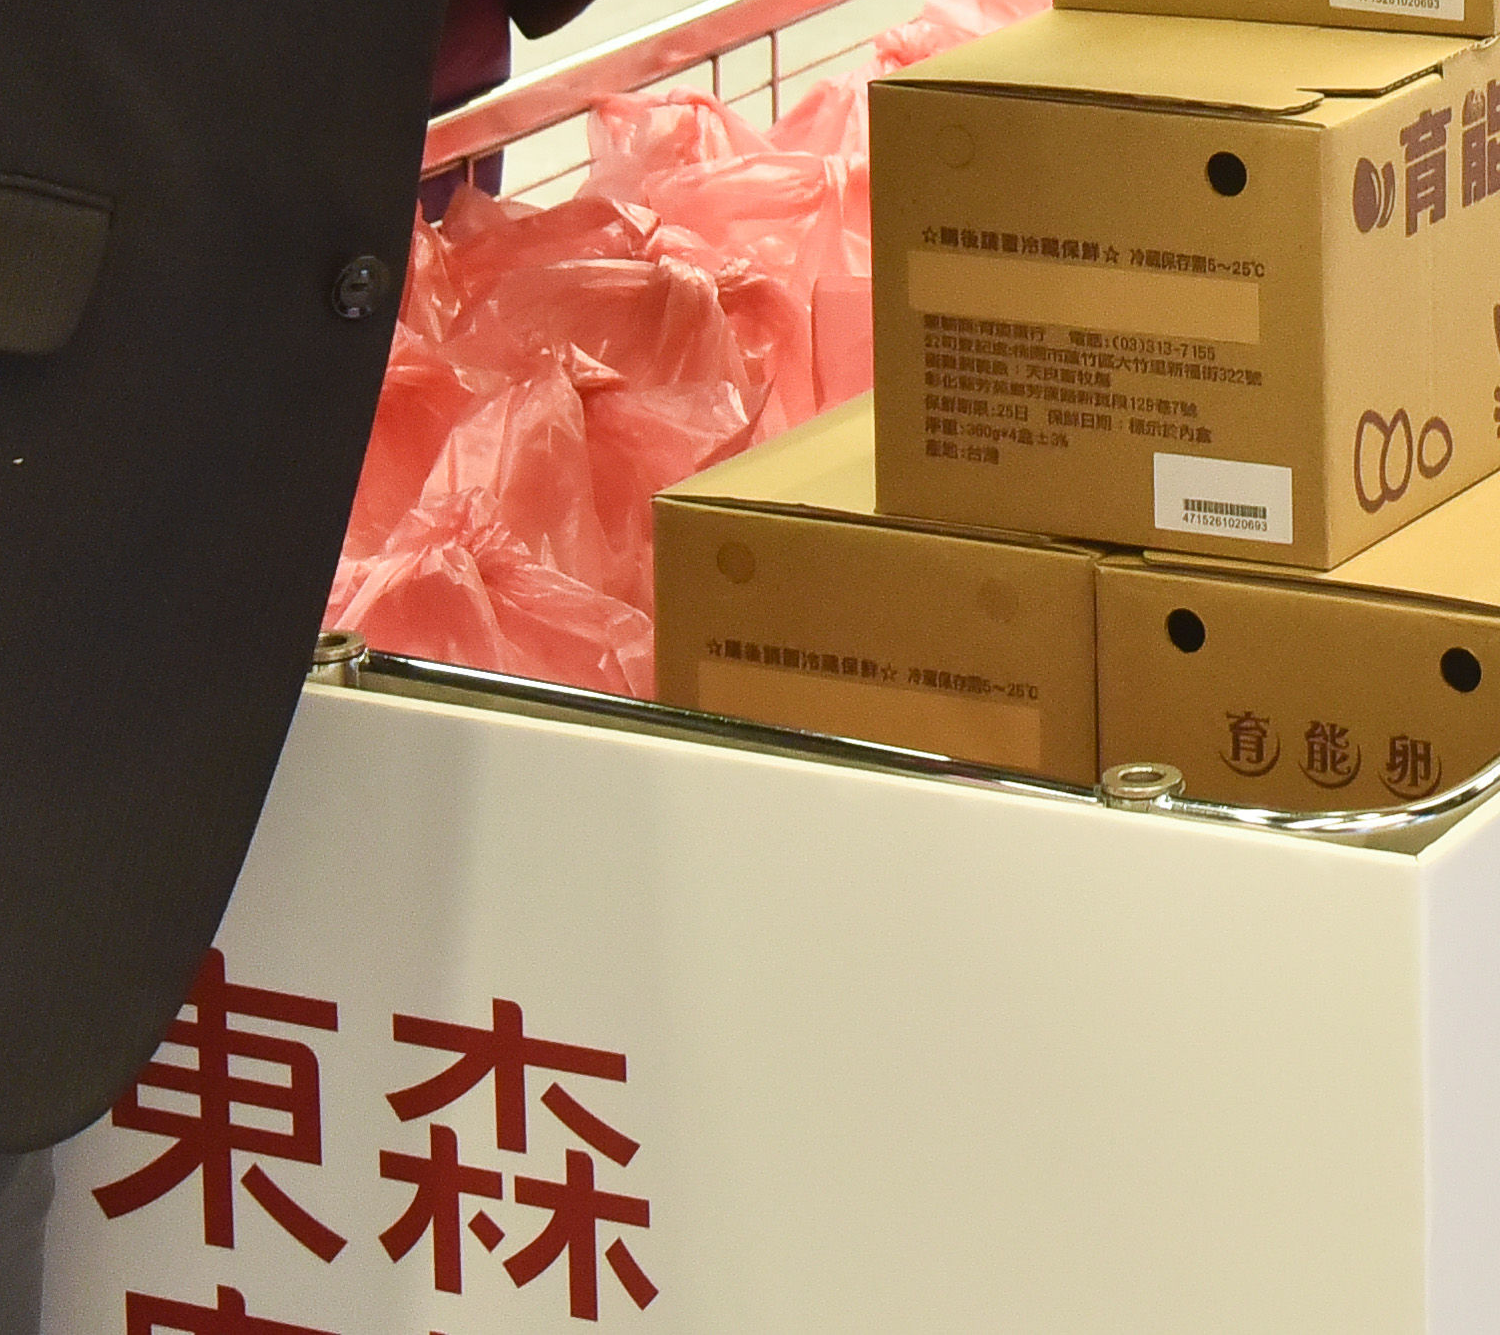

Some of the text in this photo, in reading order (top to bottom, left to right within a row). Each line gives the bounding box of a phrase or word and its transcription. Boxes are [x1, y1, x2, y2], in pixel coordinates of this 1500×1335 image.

[1181, 511, 1268, 533] 4715261020693
[1226, 710, 1432, 788] 育能卵
[92, 947, 659, 1322] 東森
